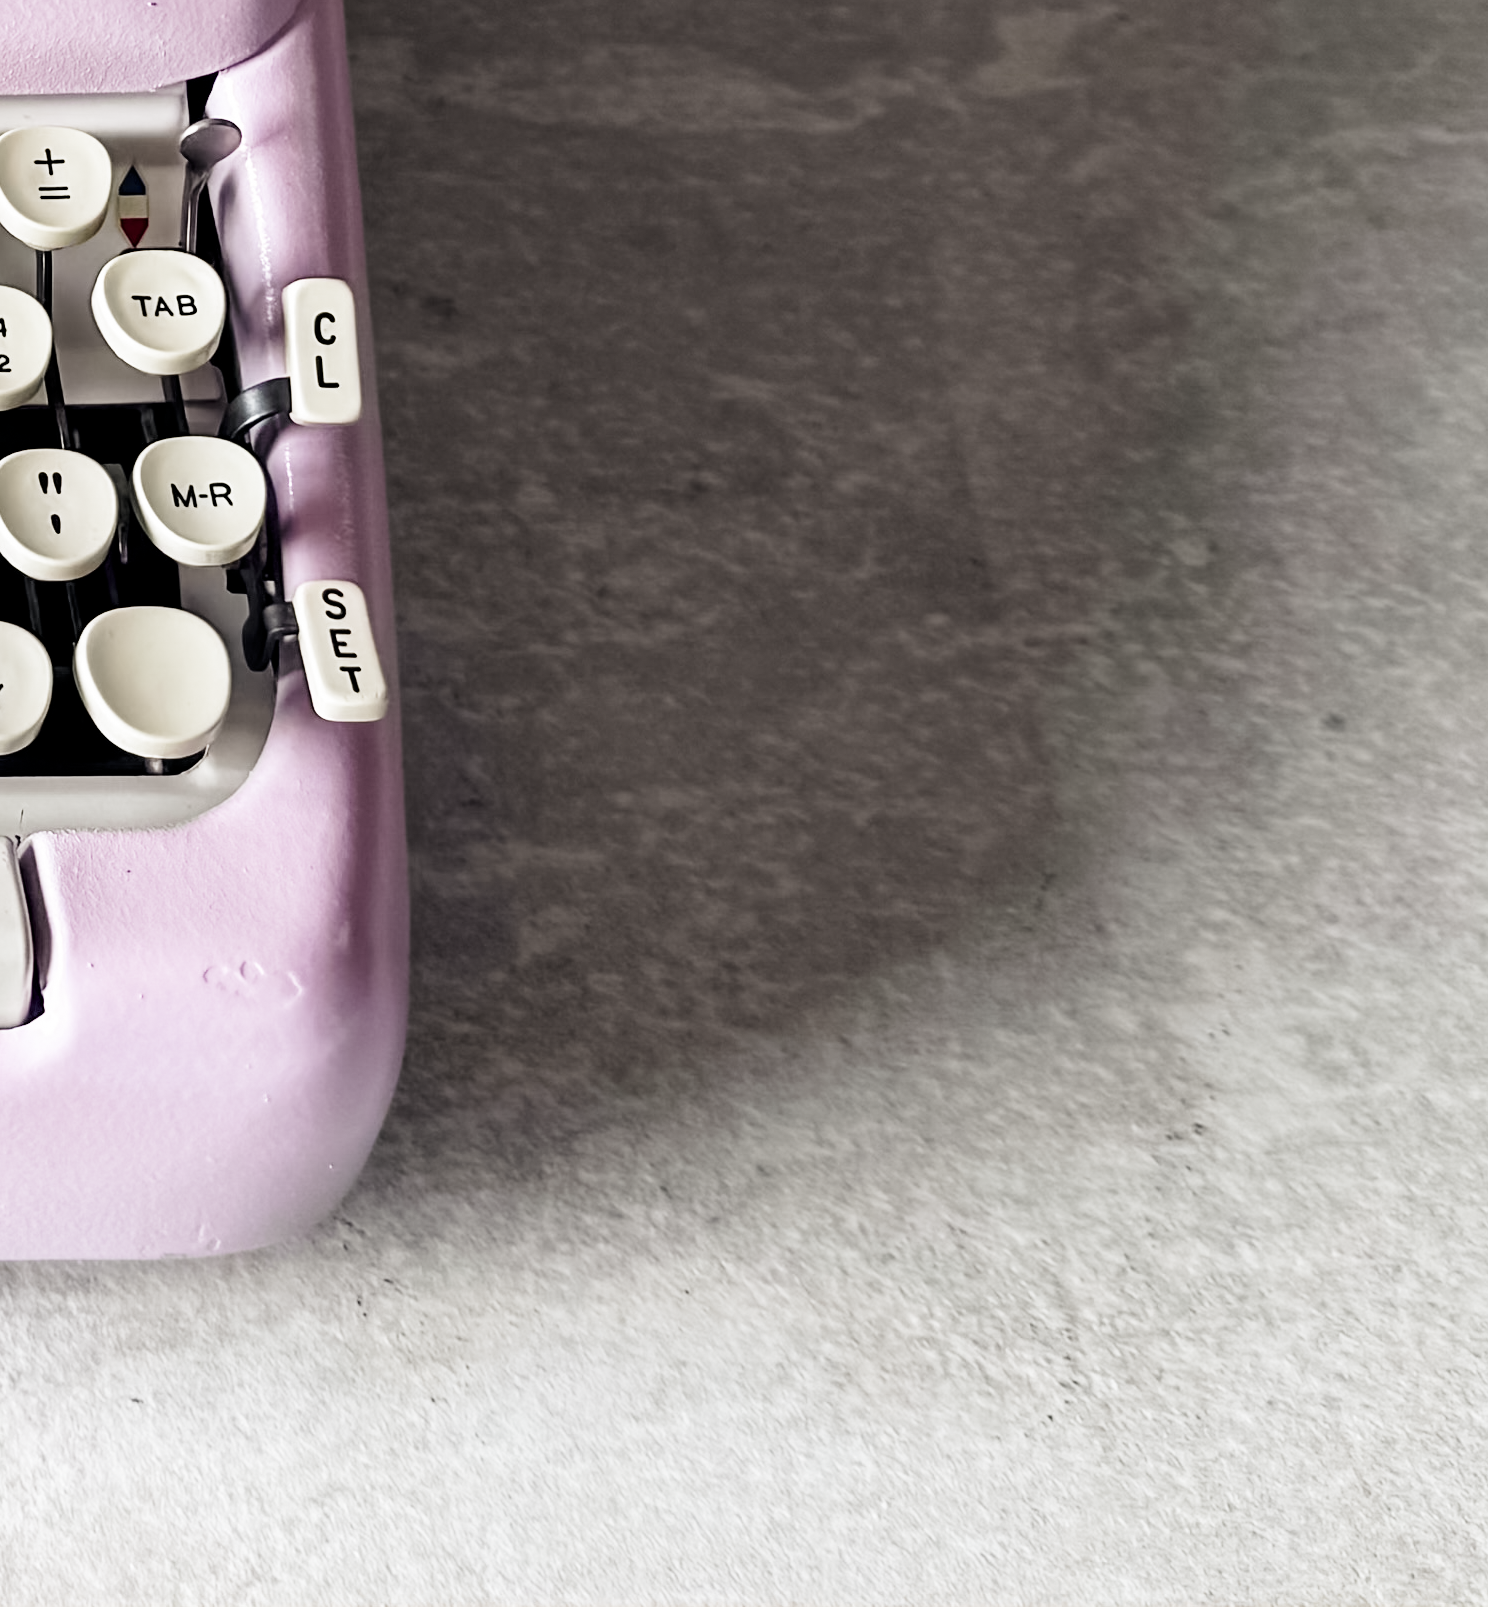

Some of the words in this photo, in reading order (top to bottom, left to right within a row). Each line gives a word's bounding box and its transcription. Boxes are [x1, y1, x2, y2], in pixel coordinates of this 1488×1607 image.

[33, 148, 66, 176] +
[38, 186, 71, 200] =
[131, 294, 198, 318] TAB
[170, 482, 234, 508] M-R
